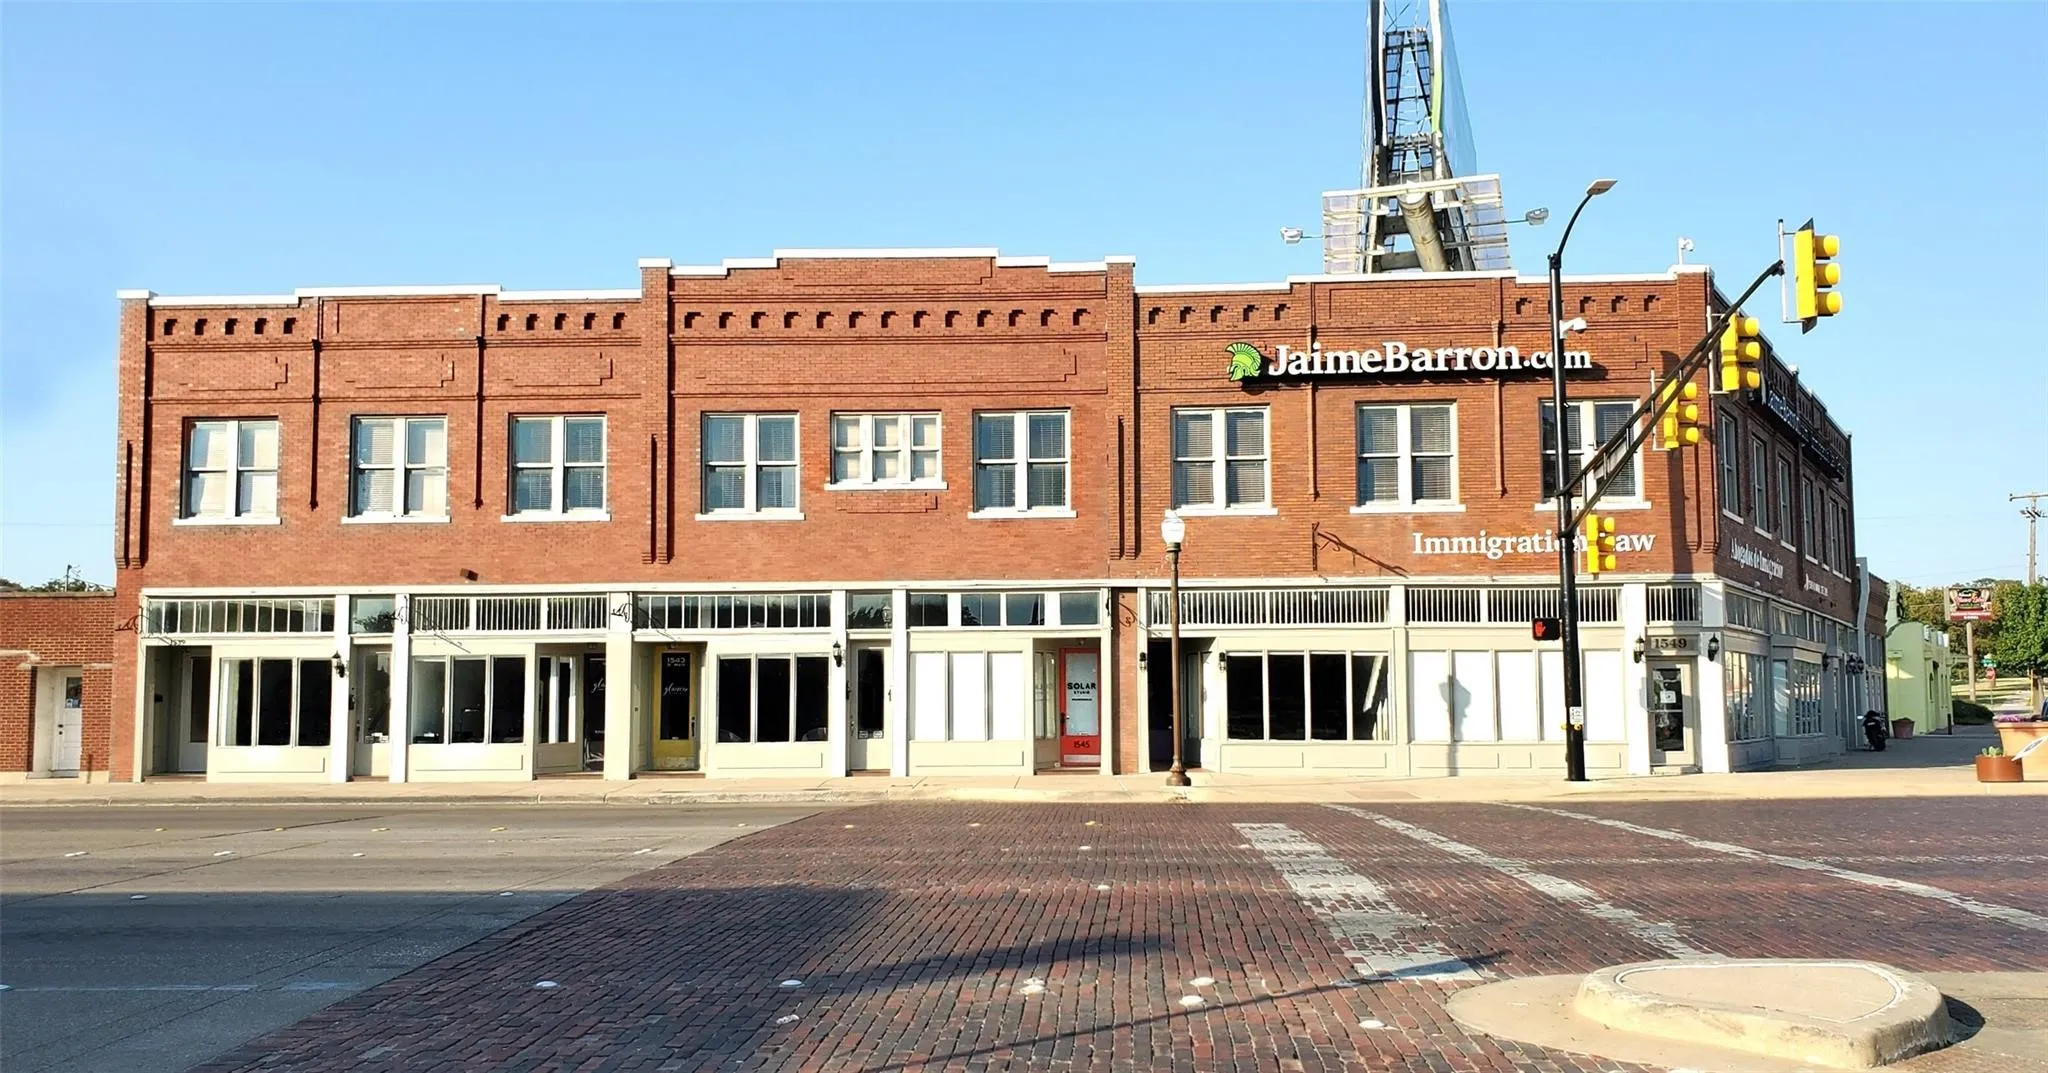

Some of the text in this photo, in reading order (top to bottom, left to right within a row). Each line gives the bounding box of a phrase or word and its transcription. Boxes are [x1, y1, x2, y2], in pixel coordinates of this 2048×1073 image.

[1598, 533, 1656, 552] aw
[1654, 638, 1688, 649] 1549
[1067, 682, 1097, 690] SOLAR
[1073, 740, 1090, 749] 1545
